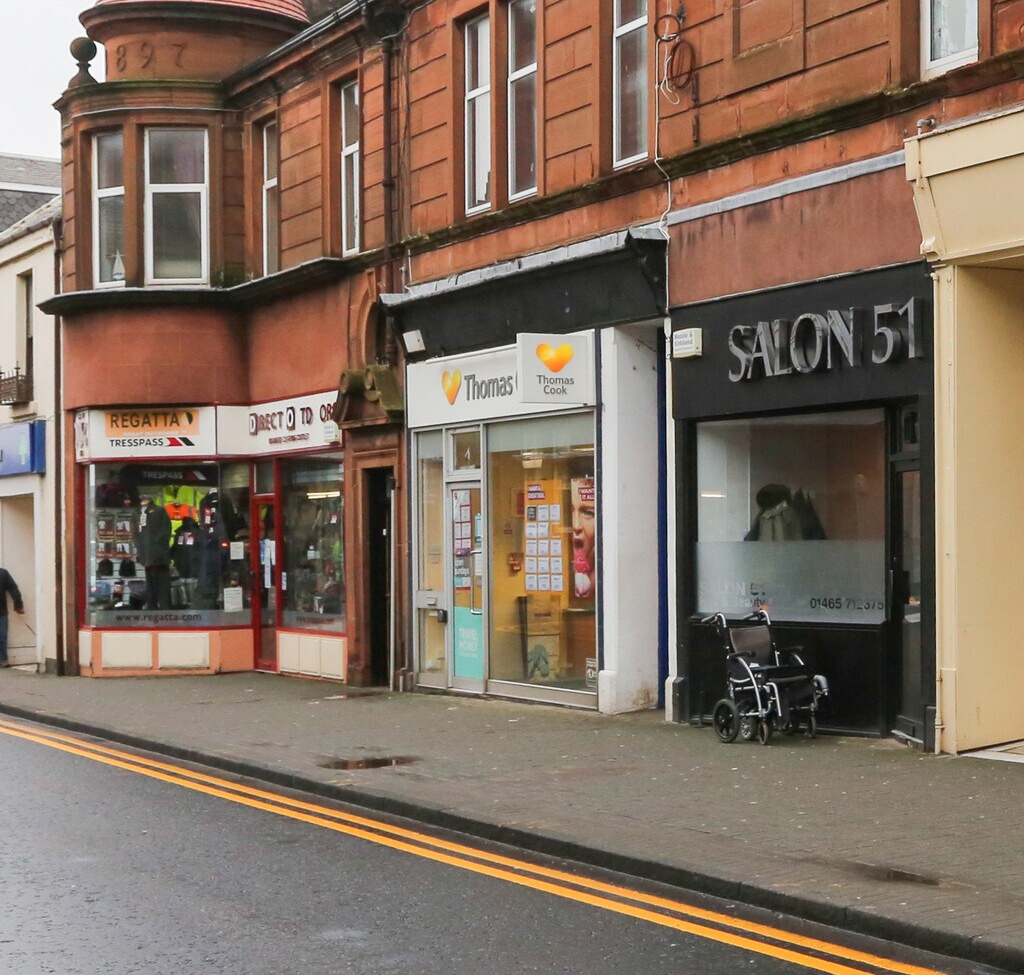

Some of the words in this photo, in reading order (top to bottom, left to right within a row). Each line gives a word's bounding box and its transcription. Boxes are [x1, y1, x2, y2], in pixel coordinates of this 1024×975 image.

[728, 306, 862, 383] SALON
[871, 296, 924, 364] 51
[537, 374, 575, 385] Thomas
[464, 373, 514, 402] Thomas
[543, 384, 568, 395] Cook
[110, 411, 180, 429] REGATTA
[110, 437, 164, 448] TRESSPASS
[809, 597, 842, 610] 01465
[115, 613, 202, 624] www.regatta.com
